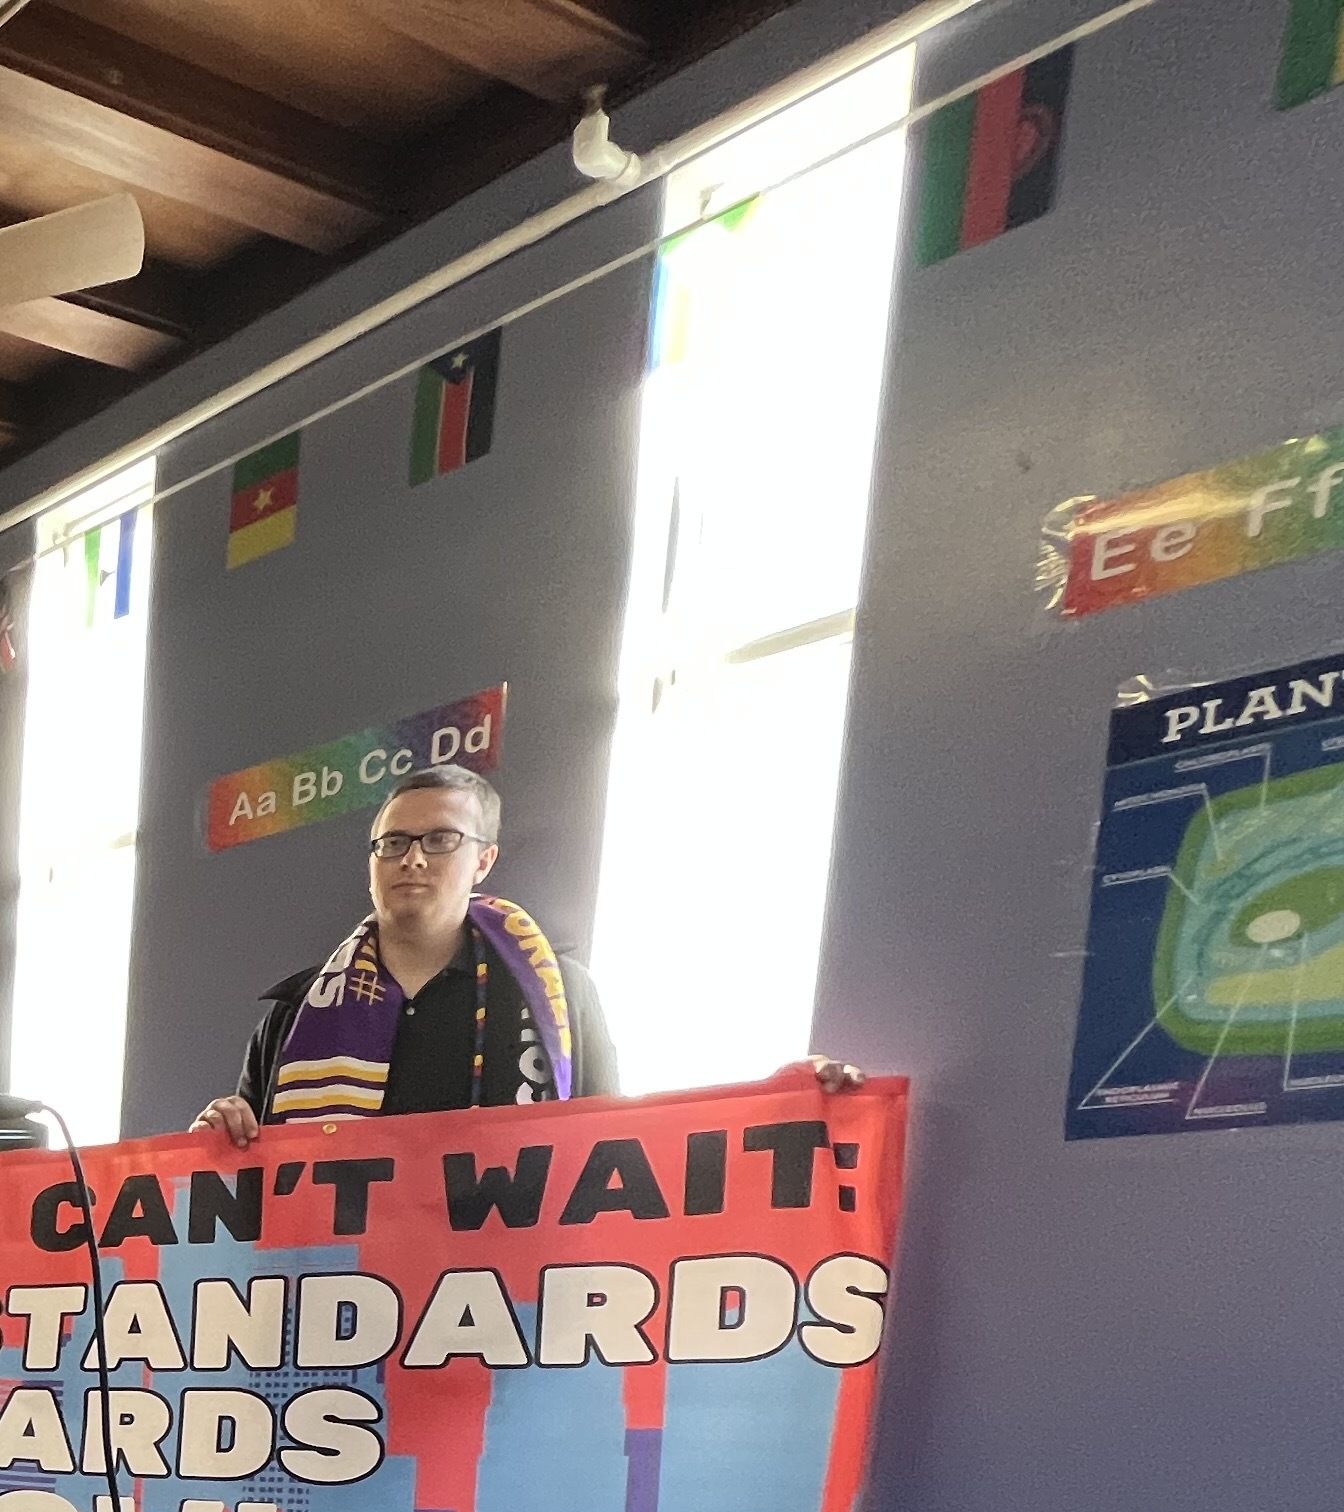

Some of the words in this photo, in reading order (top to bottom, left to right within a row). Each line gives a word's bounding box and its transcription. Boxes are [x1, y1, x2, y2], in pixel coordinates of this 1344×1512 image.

[1090, 519, 1200, 581] Ee
[1246, 461, 1344, 538] Ff
[1162, 669, 1344, 744] PLAN
[228, 791, 277, 826] Aa
[291, 765, 344, 807] Bb
[359, 748, 413, 785] Cc
[430, 713, 492, 765] Dd
[30, 1158, 395, 1253] CAN'T
[442, 1120, 861, 1231] WAIT:
